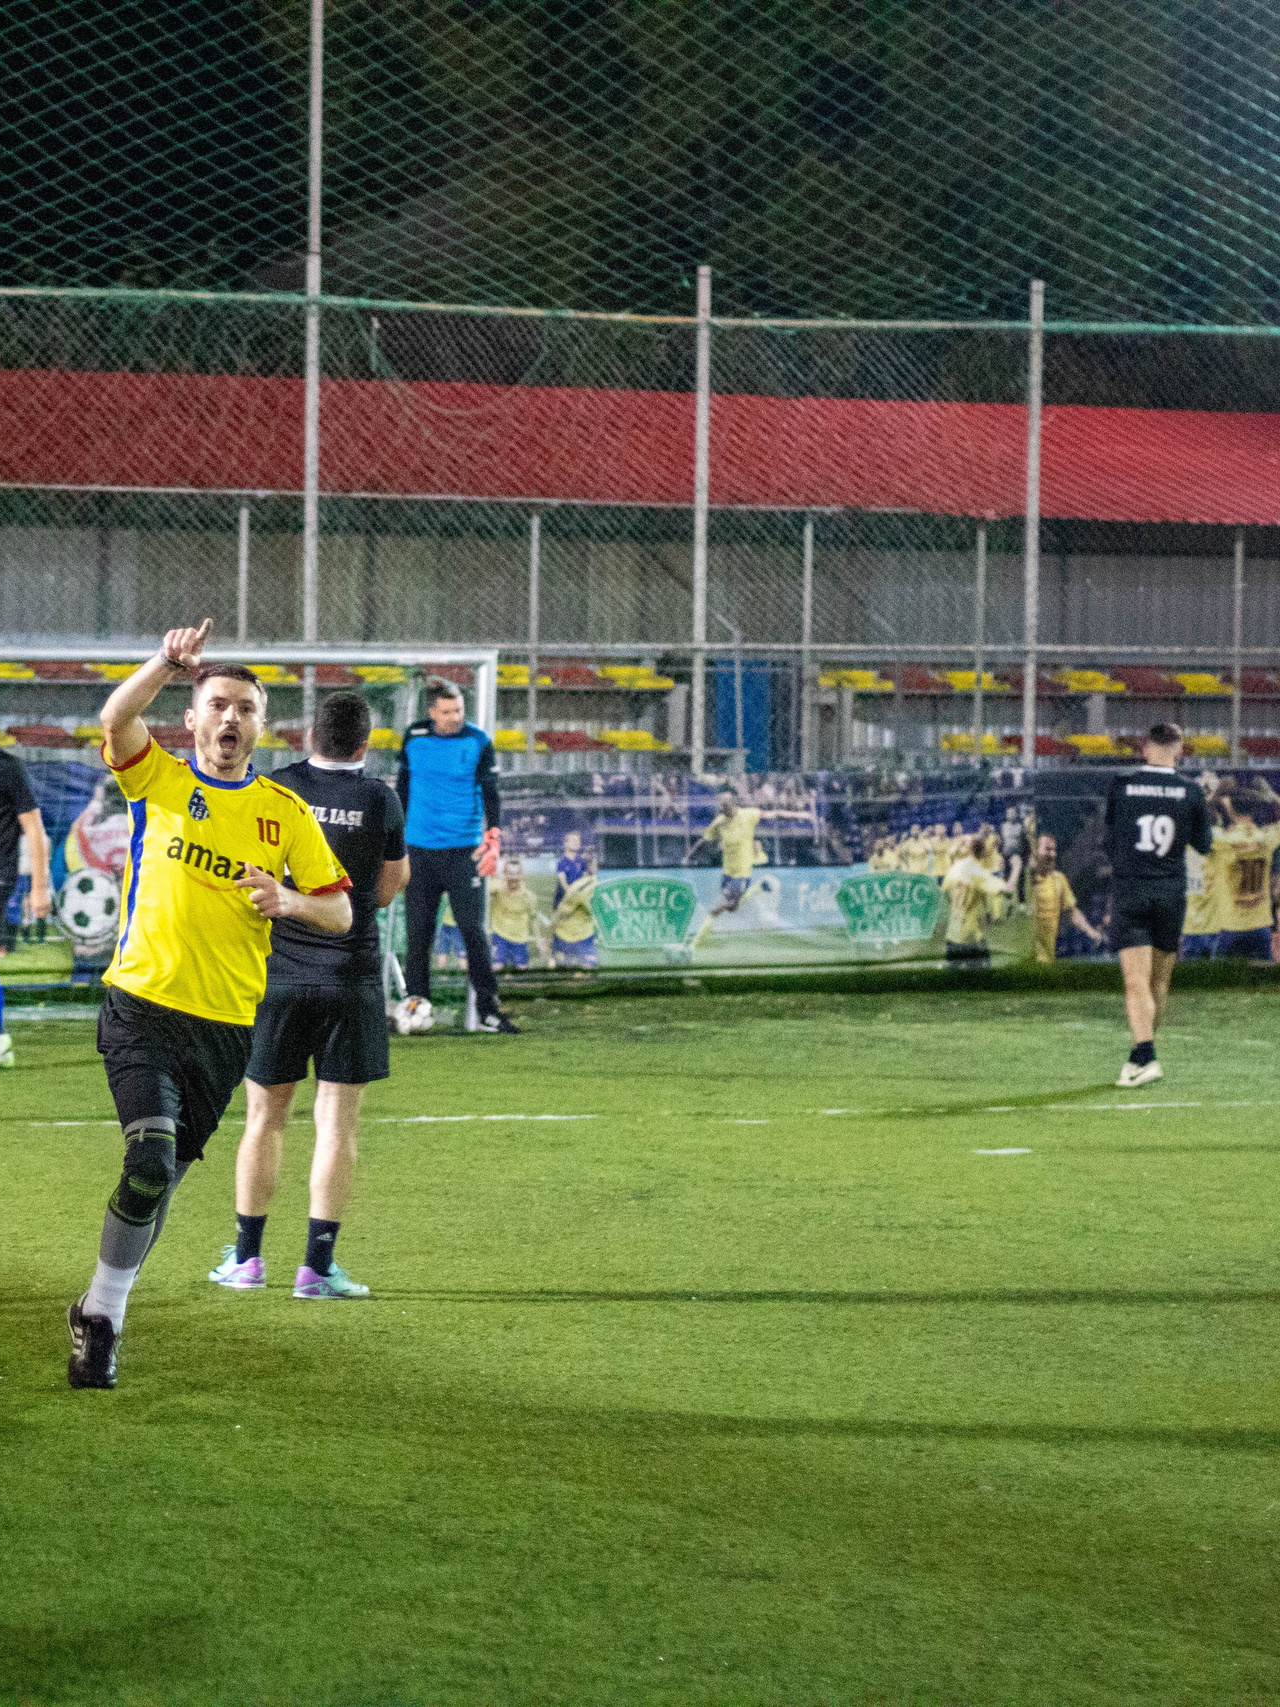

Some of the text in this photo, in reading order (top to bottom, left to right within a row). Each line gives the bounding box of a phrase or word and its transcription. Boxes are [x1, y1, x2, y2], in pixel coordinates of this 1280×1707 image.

[256, 817, 280, 846] 10
[1135, 814, 1175, 857] 19
[166, 836, 275, 881] amaz
[601, 886, 687, 913] MAGIC
[848, 880, 930, 907] MAGIC
